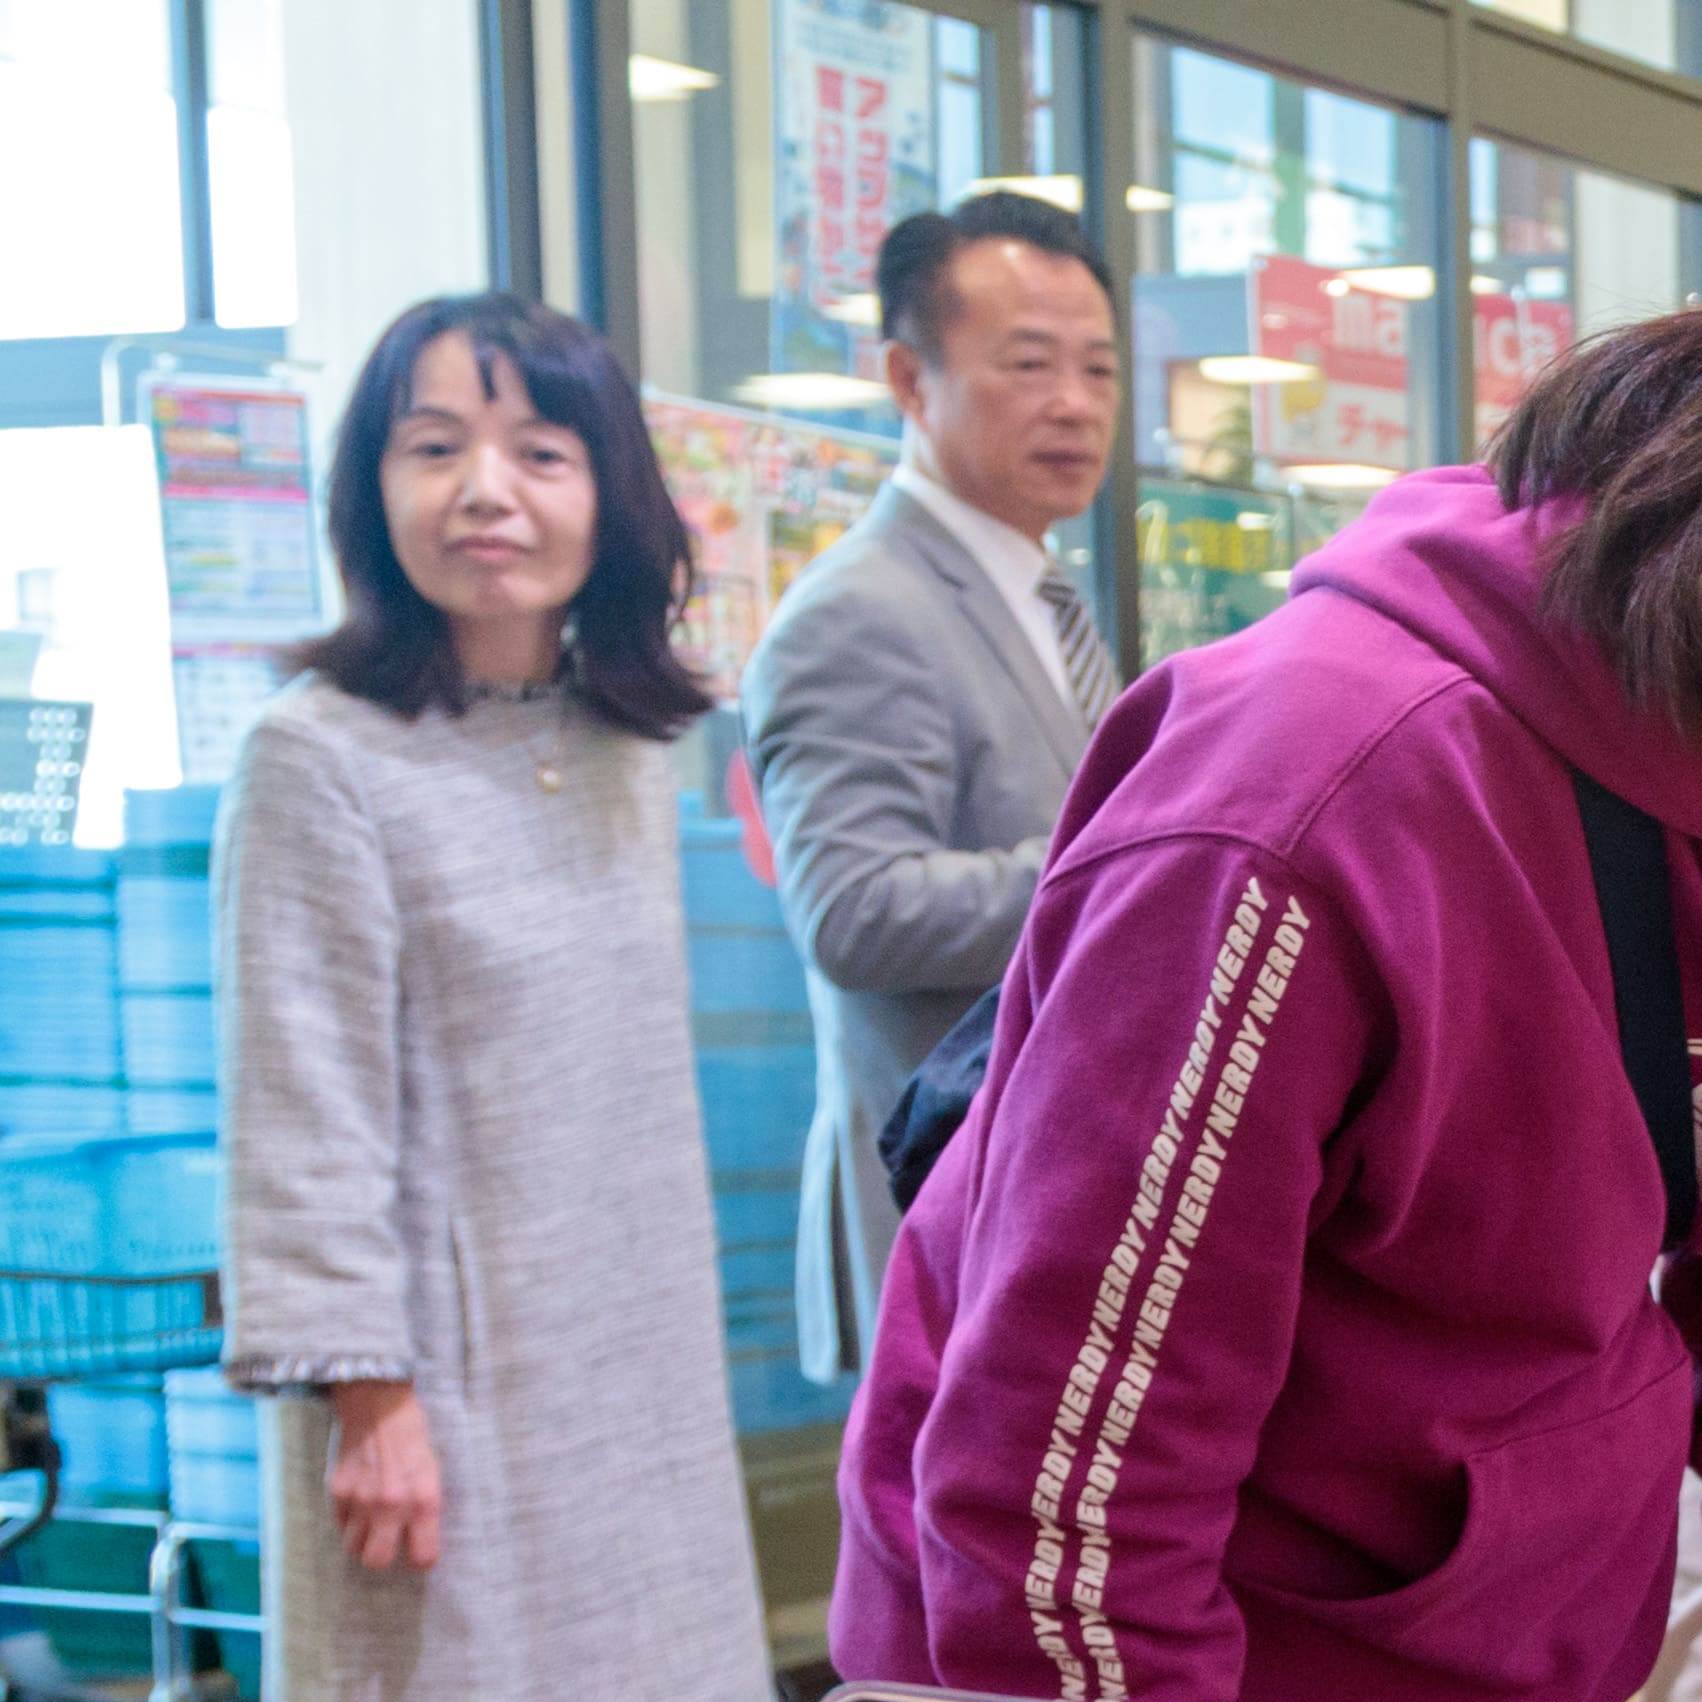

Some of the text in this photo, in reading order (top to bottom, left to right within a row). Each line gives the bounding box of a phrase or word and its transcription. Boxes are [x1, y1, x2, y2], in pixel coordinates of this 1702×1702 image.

[1210, 876, 1269, 1006] NERDY
[1170, 994, 1223, 1121] NERDY
[1100, 1339, 1159, 1448] NERDY
[1132, 1238, 1191, 1350] NERDY
[1169, 1128, 1228, 1249] NERDY
[1206, 1014, 1267, 1138] NERDY
[1247, 895, 1311, 1025] NERDY
[1131, 1108, 1184, 1230] NERDY
[1093, 1218, 1147, 1332] NERDY
[1054, 1320, 1115, 1437] NERDY
[1031, 1428, 1078, 1521] ERDY
